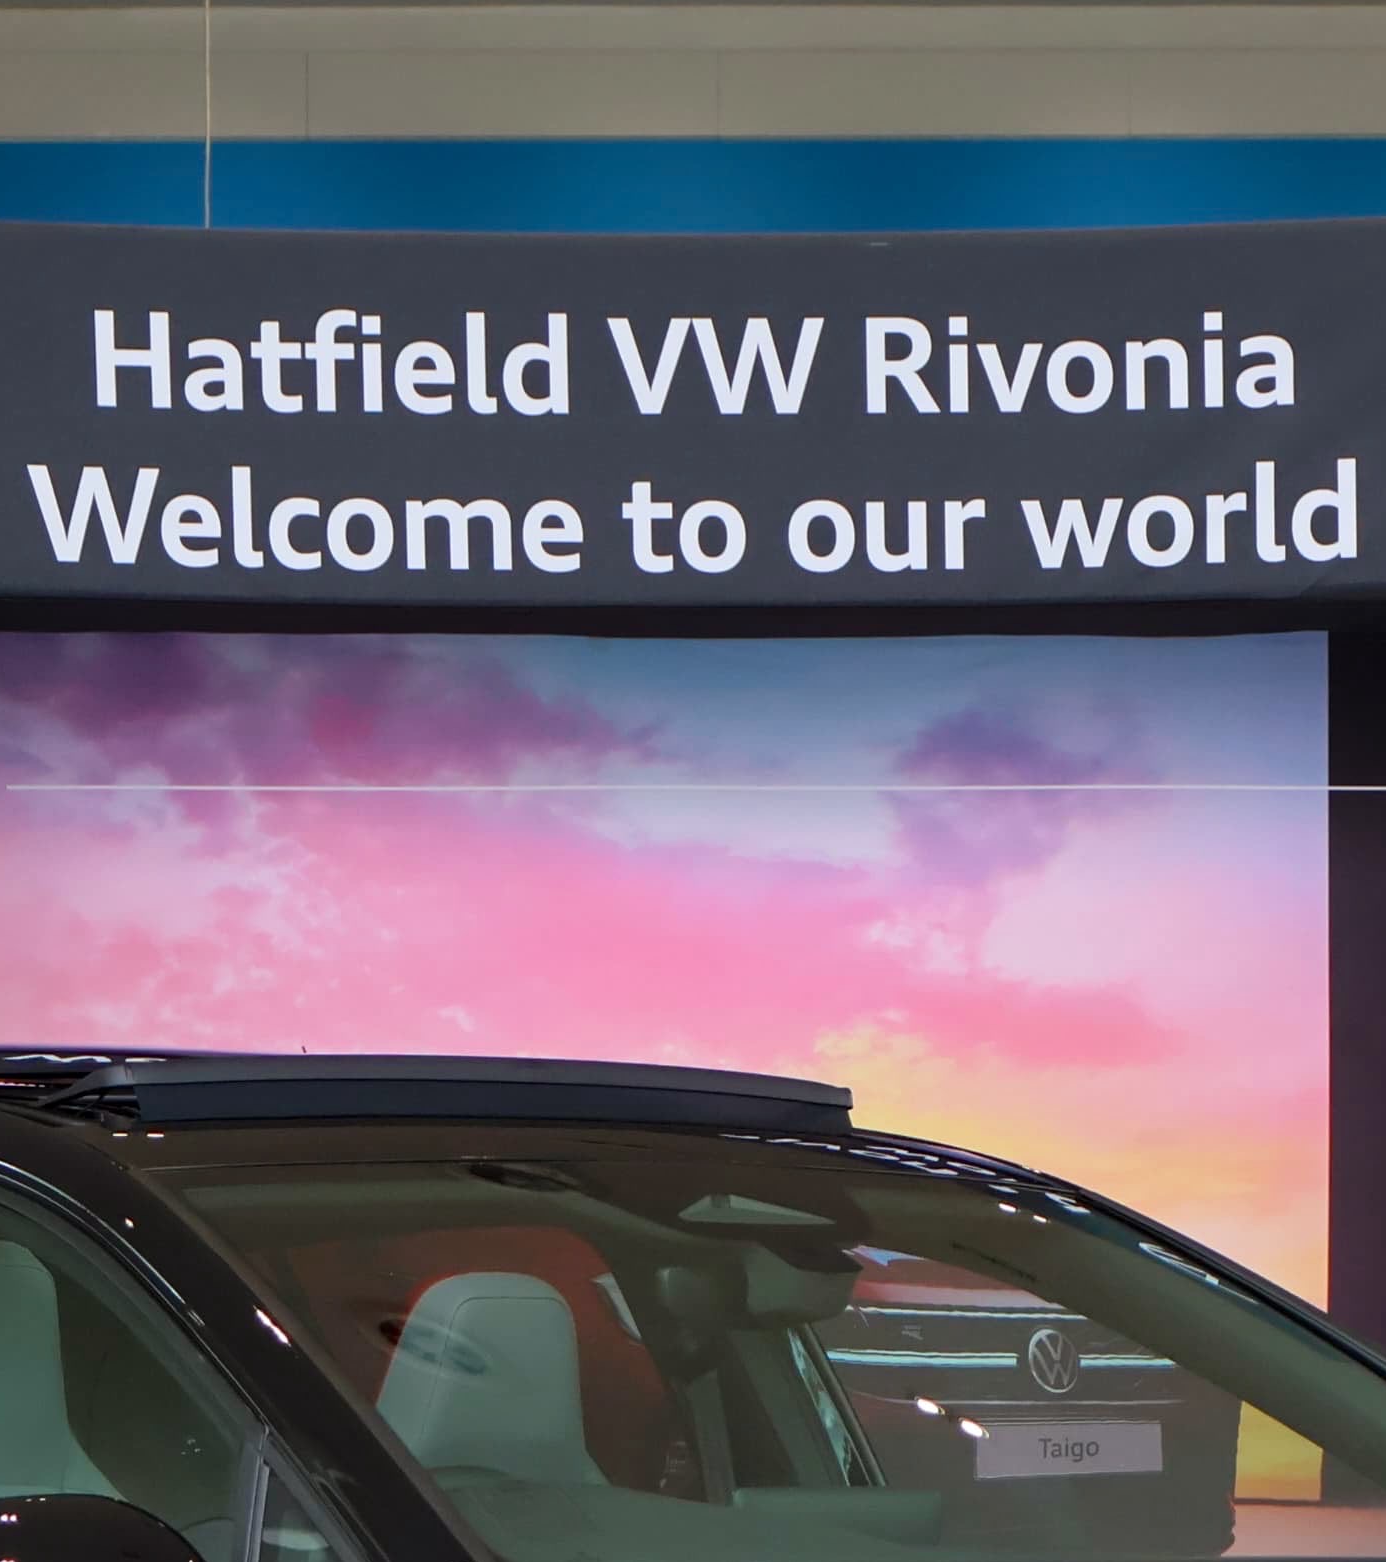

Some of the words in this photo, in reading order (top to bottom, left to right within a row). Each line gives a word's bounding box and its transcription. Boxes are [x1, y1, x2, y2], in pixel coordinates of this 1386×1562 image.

[94, 309, 570, 416] Hatfield
[606, 317, 825, 415] VW
[865, 311, 1295, 414] Rivonia
[26, 464, 584, 573] Welcome
[621, 481, 747, 574] to
[788, 498, 986, 573] our
[1020, 457, 1358, 569] world
[1037, 1437, 1100, 1463] Taigo
